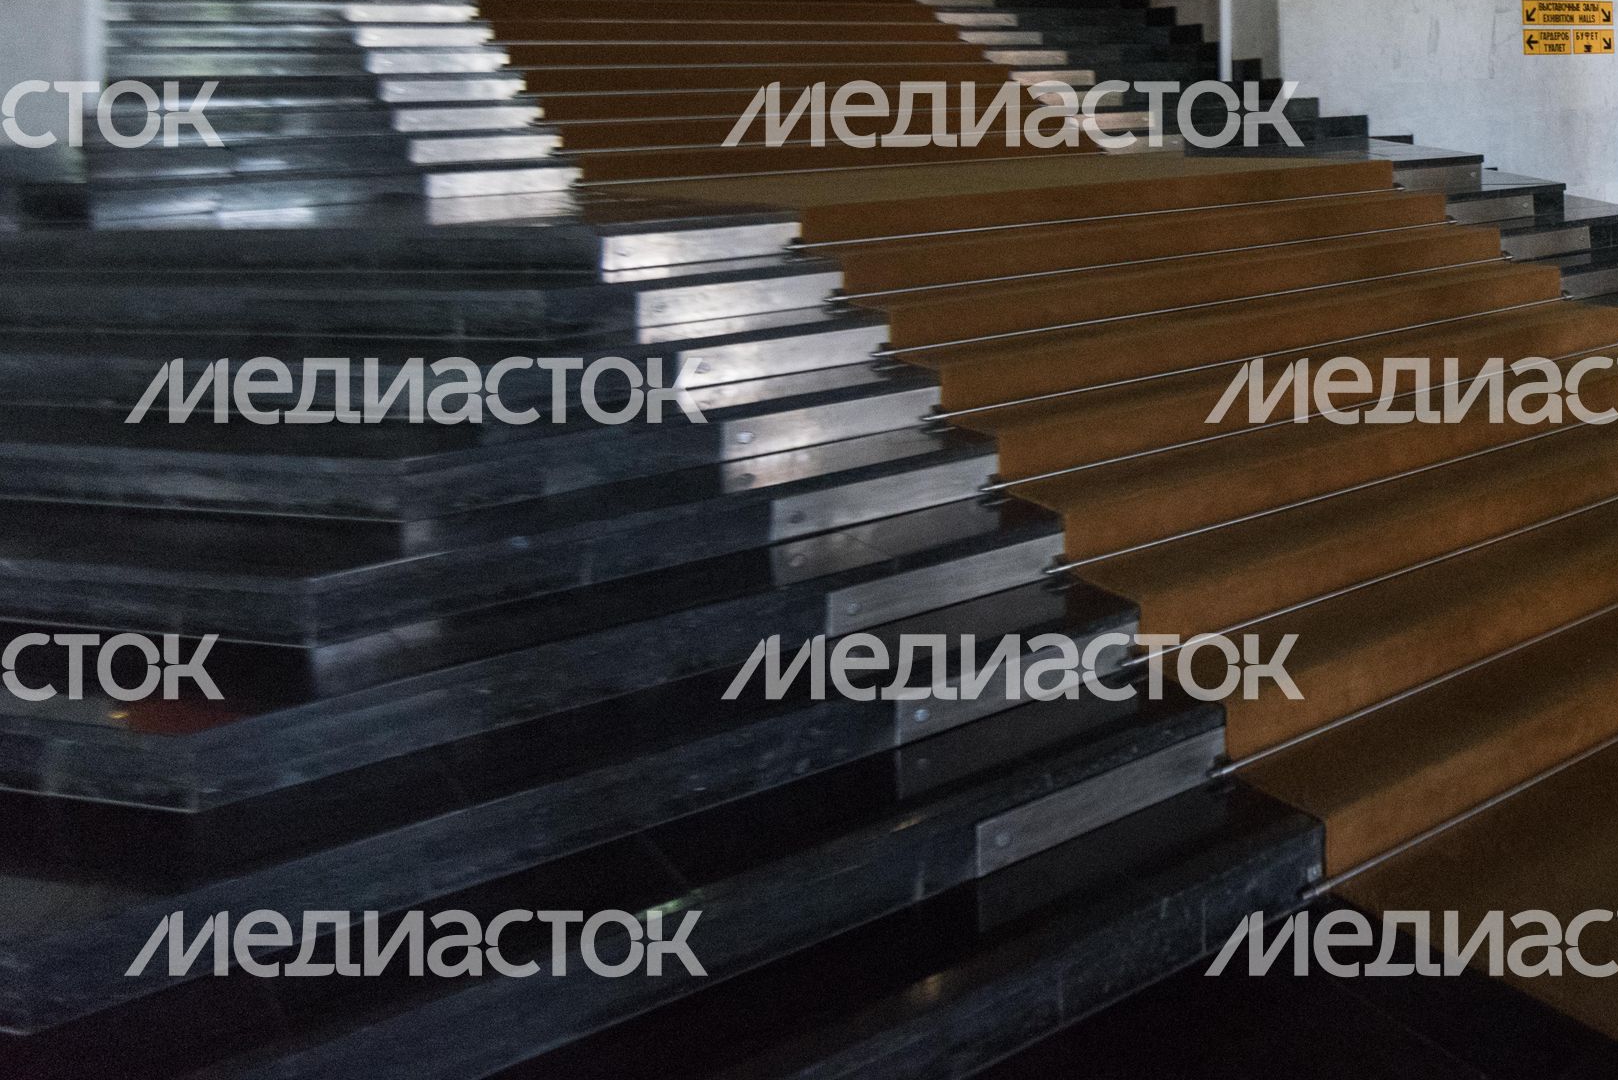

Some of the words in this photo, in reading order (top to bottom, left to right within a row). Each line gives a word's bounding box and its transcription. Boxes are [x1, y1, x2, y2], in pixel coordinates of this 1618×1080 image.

[1538, 2, 1580, 12] ВЫСТАВОЧНЫЕ
[1582, 3, 1599, 12] ЗАЛЫ
[1543, 14, 1574, 23] EXHIBITION
[1578, 14, 1596, 23] HALLS
[1540, 31, 1570, 41] ГАРДЕРОБ
[1575, 31, 1599, 41] БУФЕТ
[1543, 43, 1566, 53] ТУАЛЕТ
